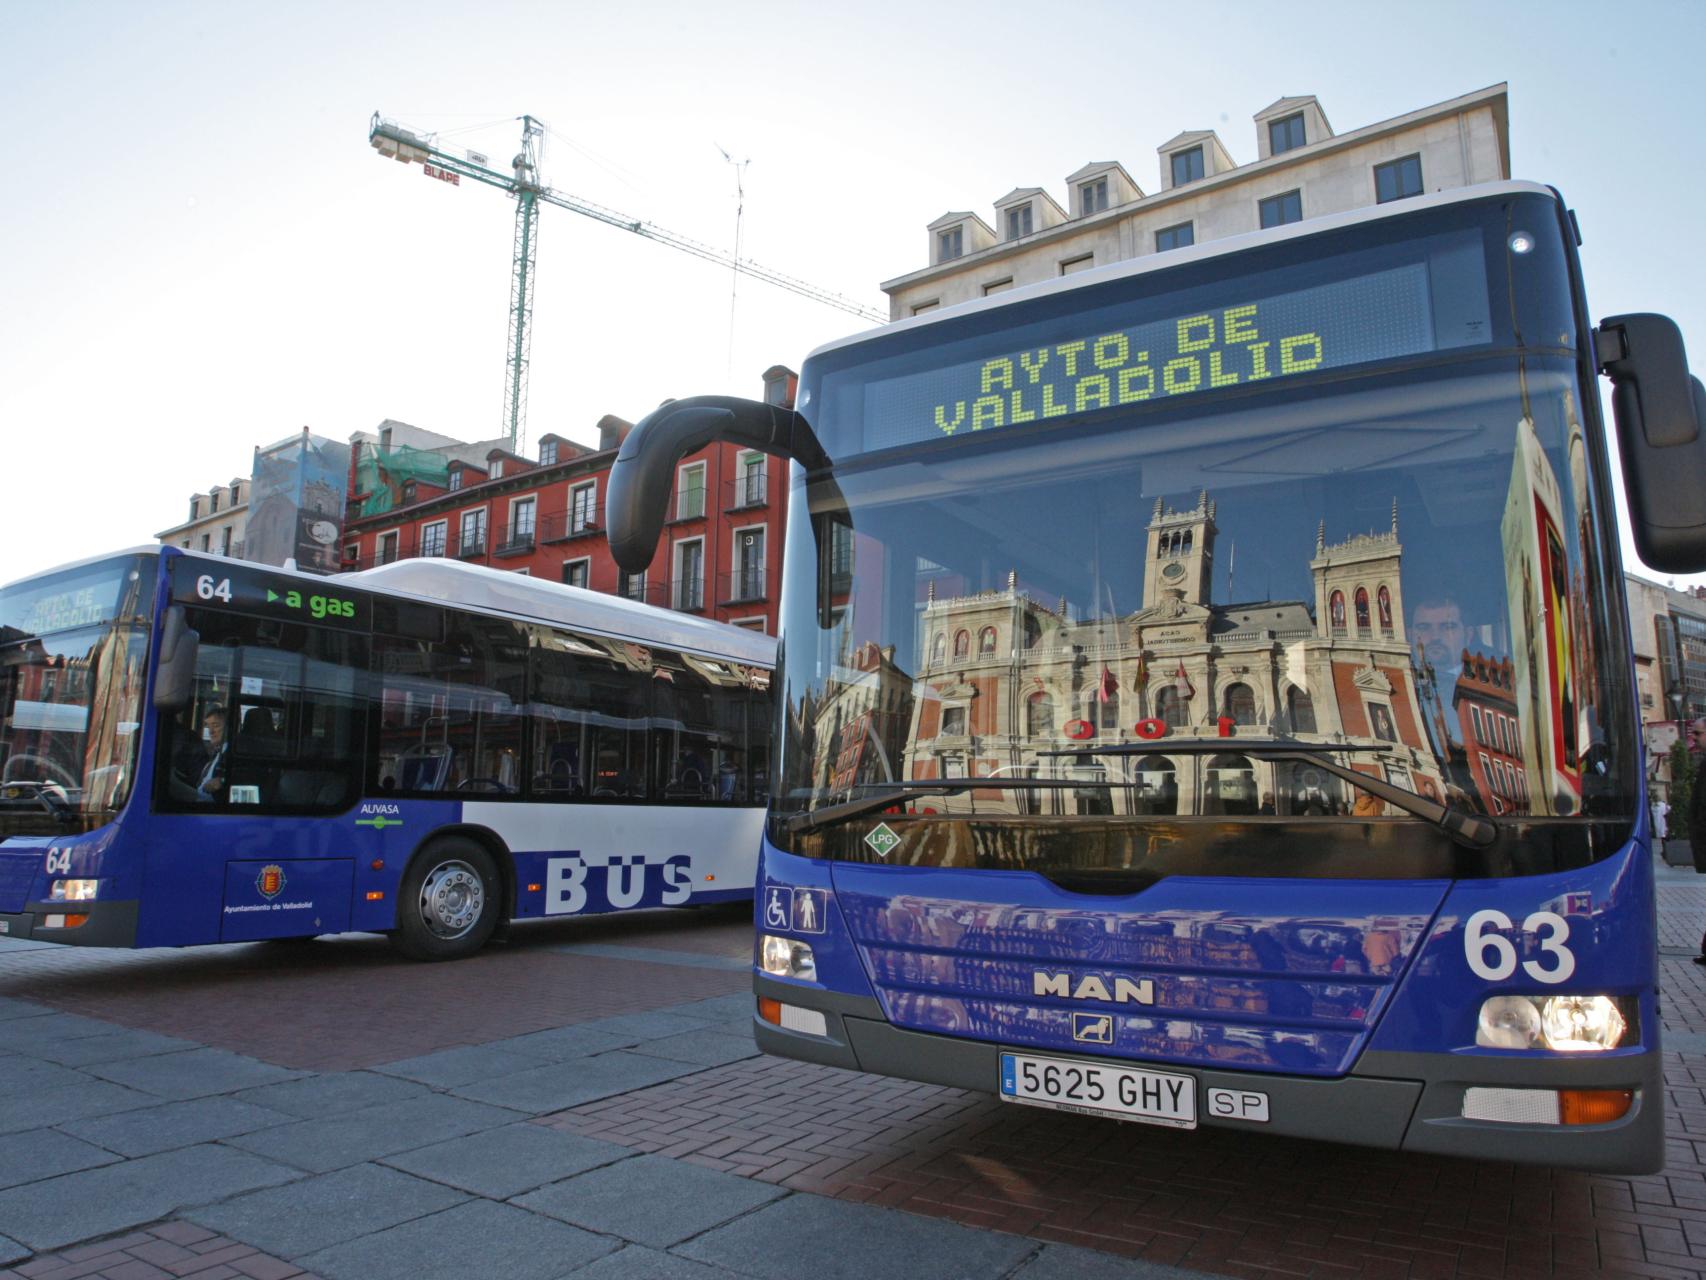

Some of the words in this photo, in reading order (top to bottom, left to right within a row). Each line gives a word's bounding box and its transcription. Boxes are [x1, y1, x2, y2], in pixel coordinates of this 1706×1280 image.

[981, 332, 1149, 393] AYTO.
[1177, 304, 1258, 354] DE
[935, 332, 1323, 435] VALLADOLID
[197, 575, 232, 603] 64
[286, 590, 302, 608] a
[310, 595, 354, 618] gas
[360, 804, 400, 814] AUVASA
[872, 834, 893, 845] LPG
[46, 847, 72, 875] 64
[545, 854, 692, 915] BUS
[224, 904, 270, 914] Ayuntamiento
[282, 901, 312, 910] Valladolid
[1464, 909, 1575, 984] 63
[1034, 972, 1153, 1005] MAN
[1005, 1079, 1013, 1088] E
[1023, 1062, 1104, 1101] 5625
[1119, 1075, 1183, 1112] GHY
[1215, 1092, 1262, 1116] SP
